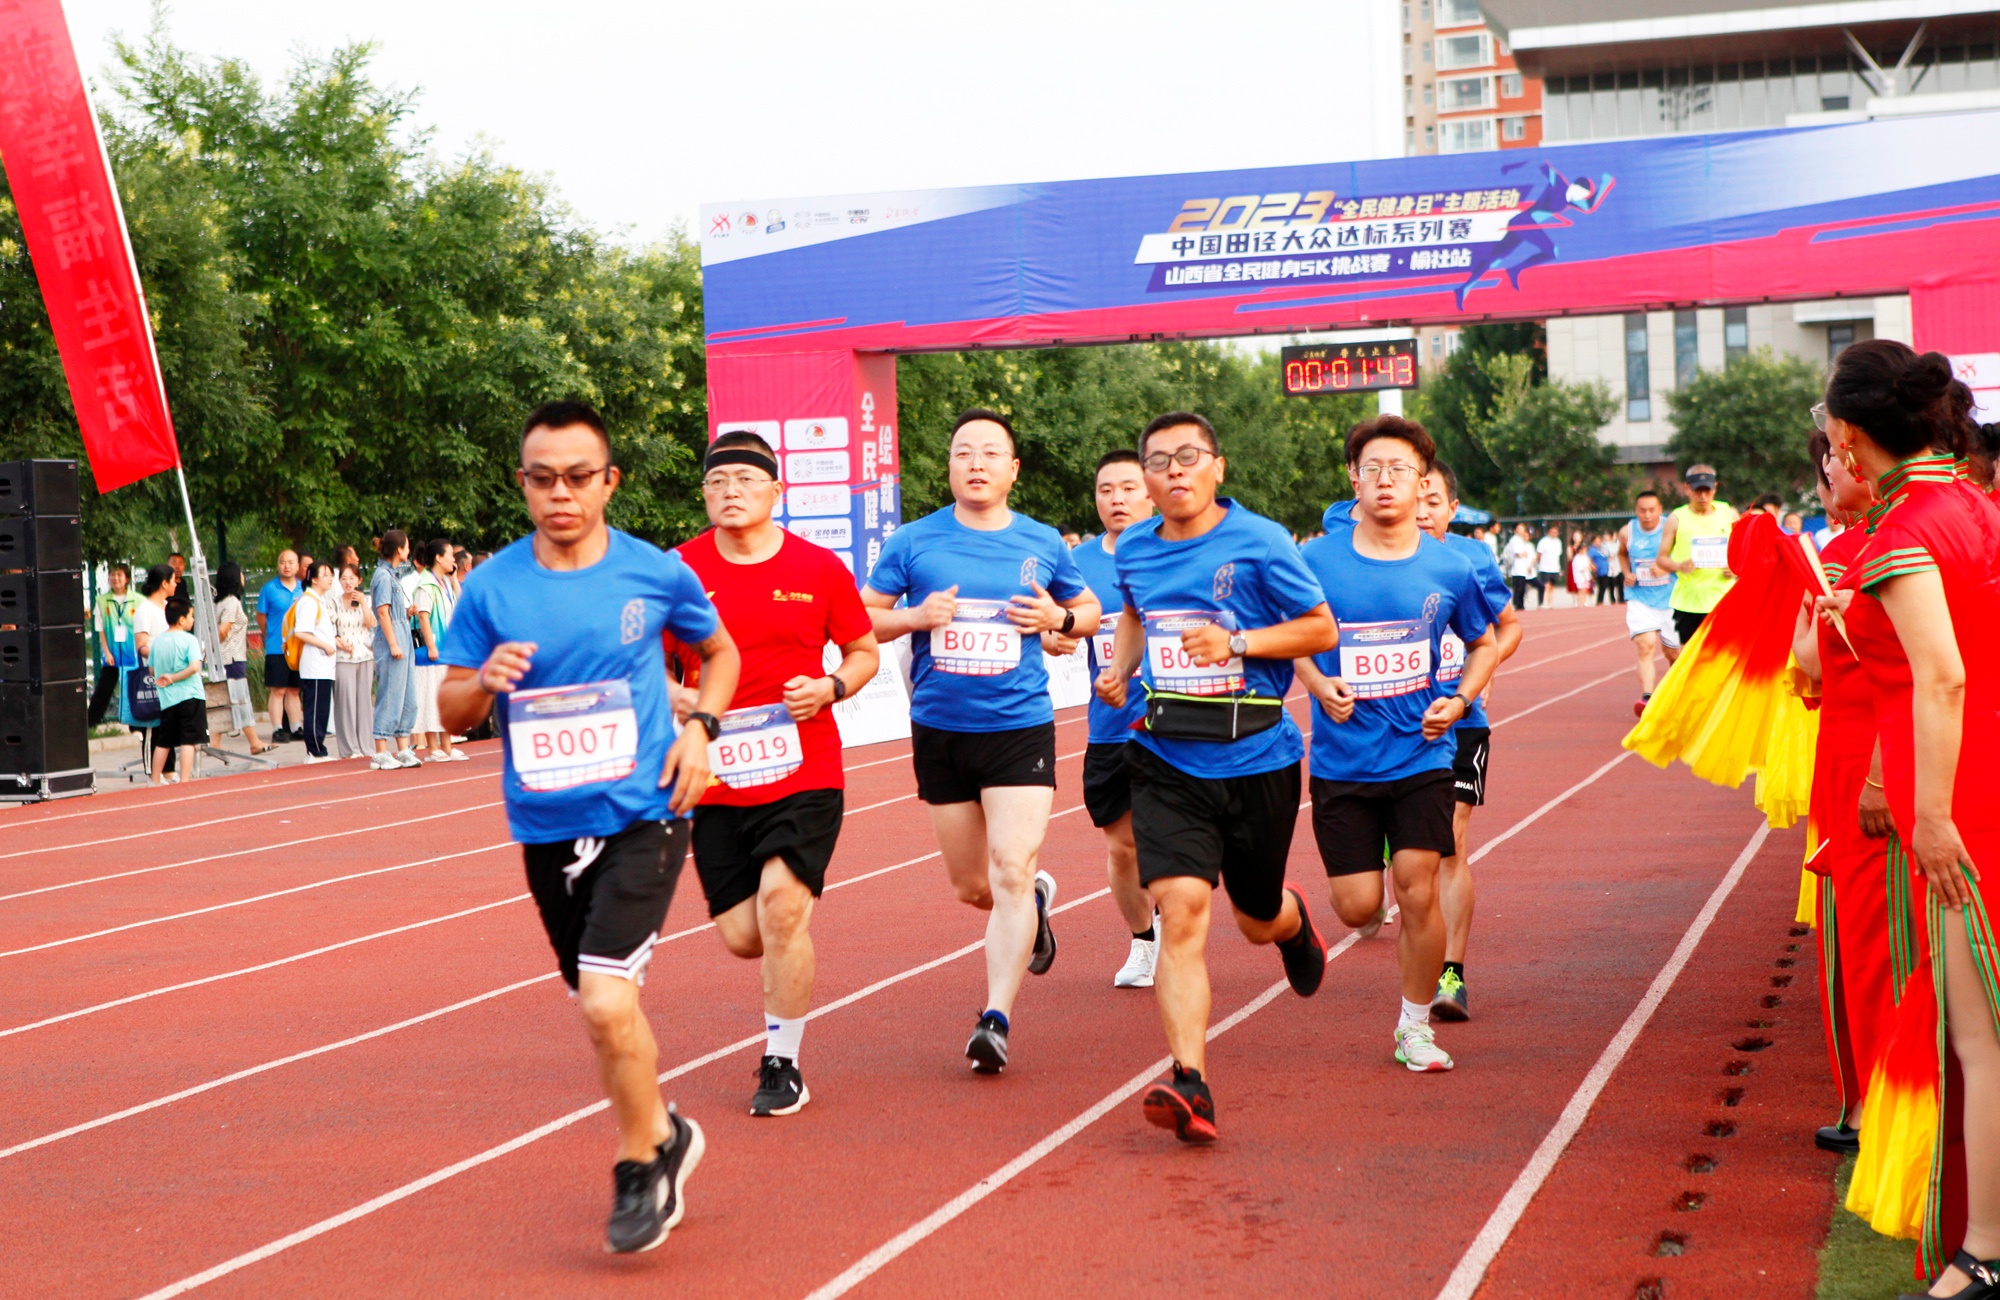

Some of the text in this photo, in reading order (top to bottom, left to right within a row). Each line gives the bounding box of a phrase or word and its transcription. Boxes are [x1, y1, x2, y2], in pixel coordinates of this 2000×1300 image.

[1168, 191, 1335, 233] 2023
[1172, 219, 1472, 257] 中国田径大众达标系列赛
[1286, 354, 1415, 392] 00:01:43
[860, 391, 881, 577] 全民健身
[944, 630, 1008, 653] B075
[1160, 647, 1229, 669] B0
[1355, 650, 1421, 676] B036
[532, 723, 618, 759] B007
[718, 736, 788, 767] B019
